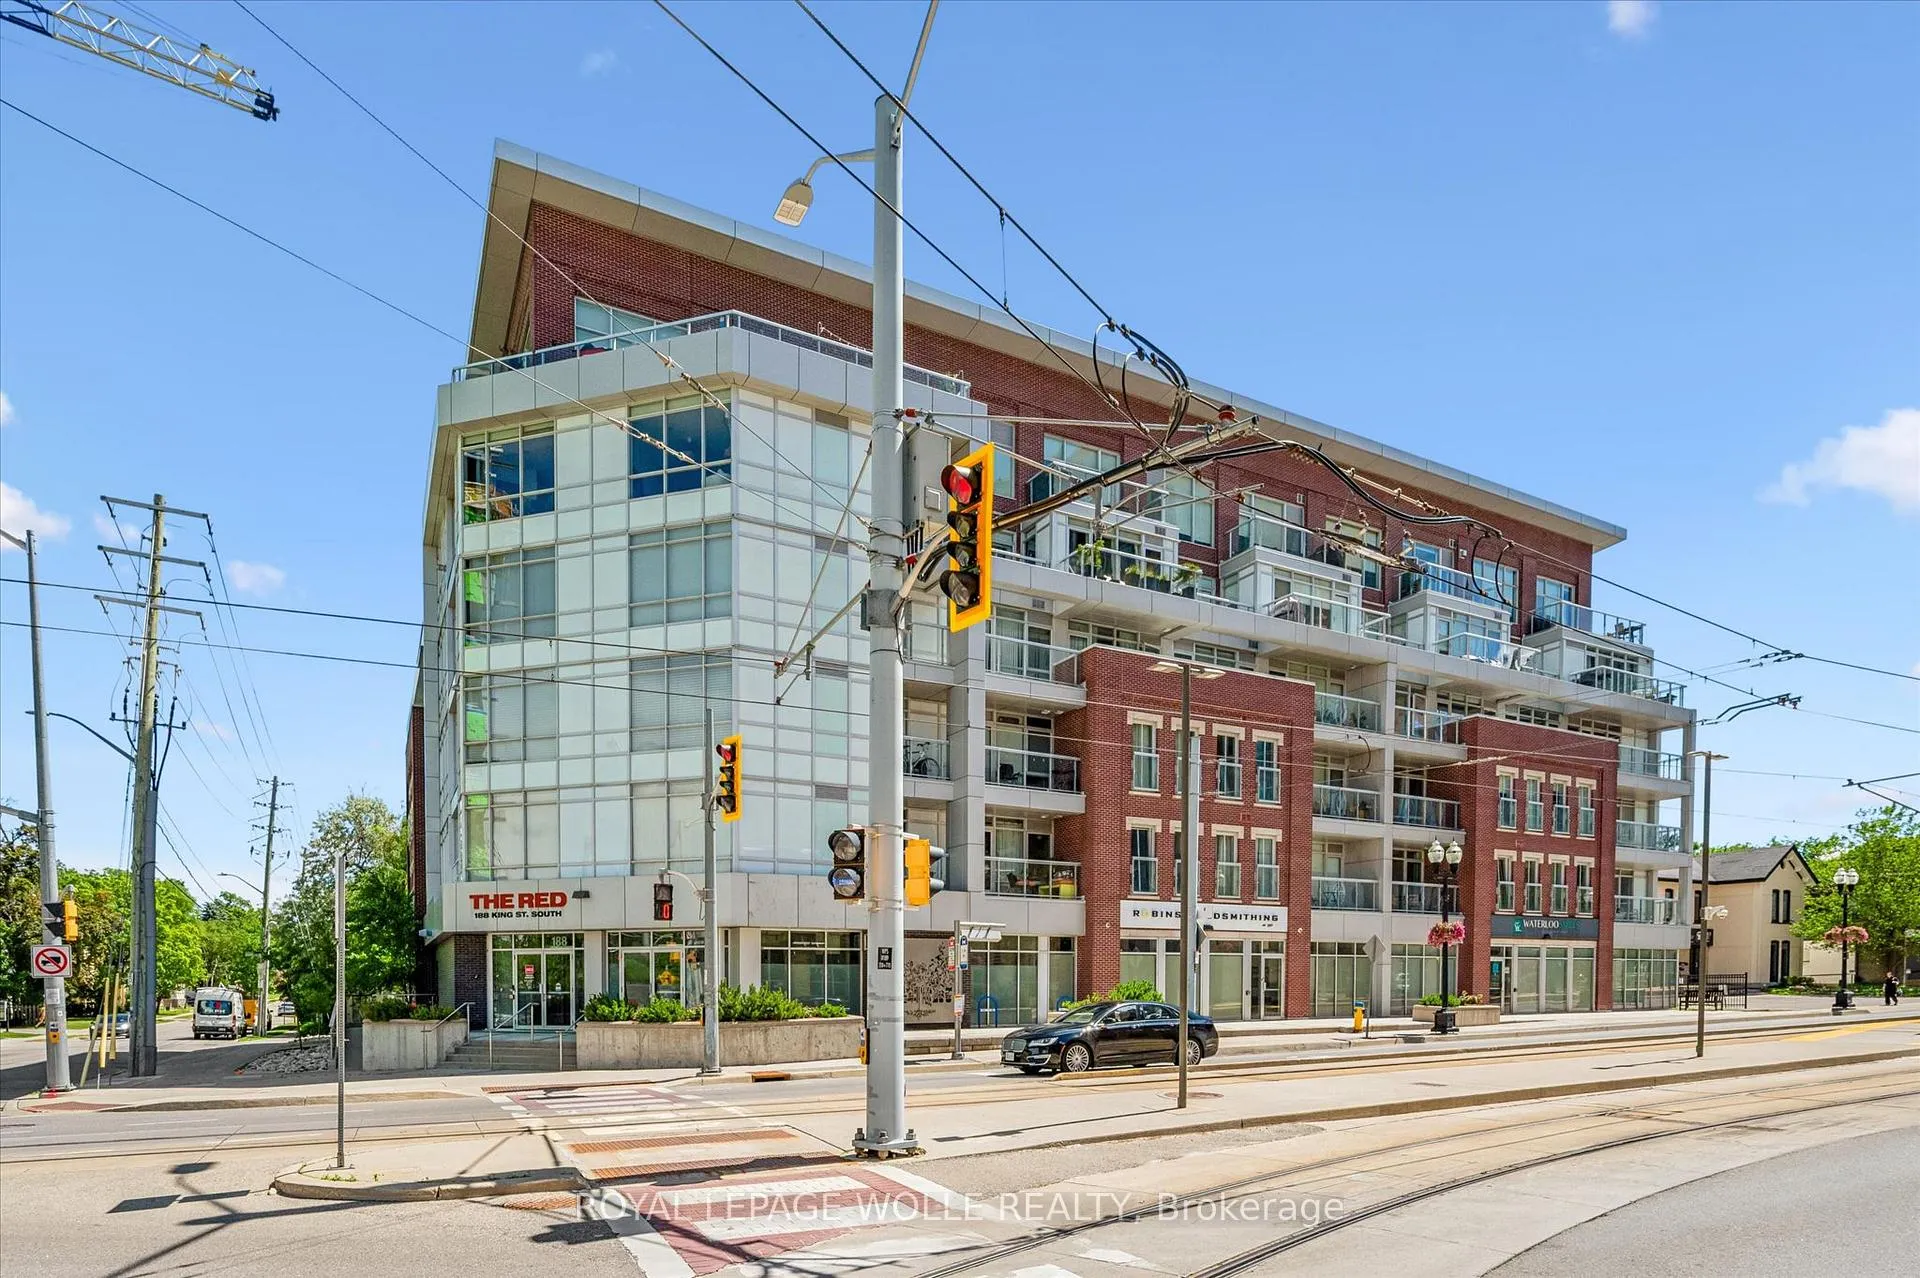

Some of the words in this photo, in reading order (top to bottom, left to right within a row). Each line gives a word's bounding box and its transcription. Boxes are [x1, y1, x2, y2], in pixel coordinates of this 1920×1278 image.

[469, 893, 514, 910] THE
[518, 892, 568, 909] RED
[531, 910, 562, 918] SOUTH
[1207, 911, 1279, 922] DSMITHING
[1523, 919, 1560, 929] WATERLOO
[552, 935, 567, 947] 188
